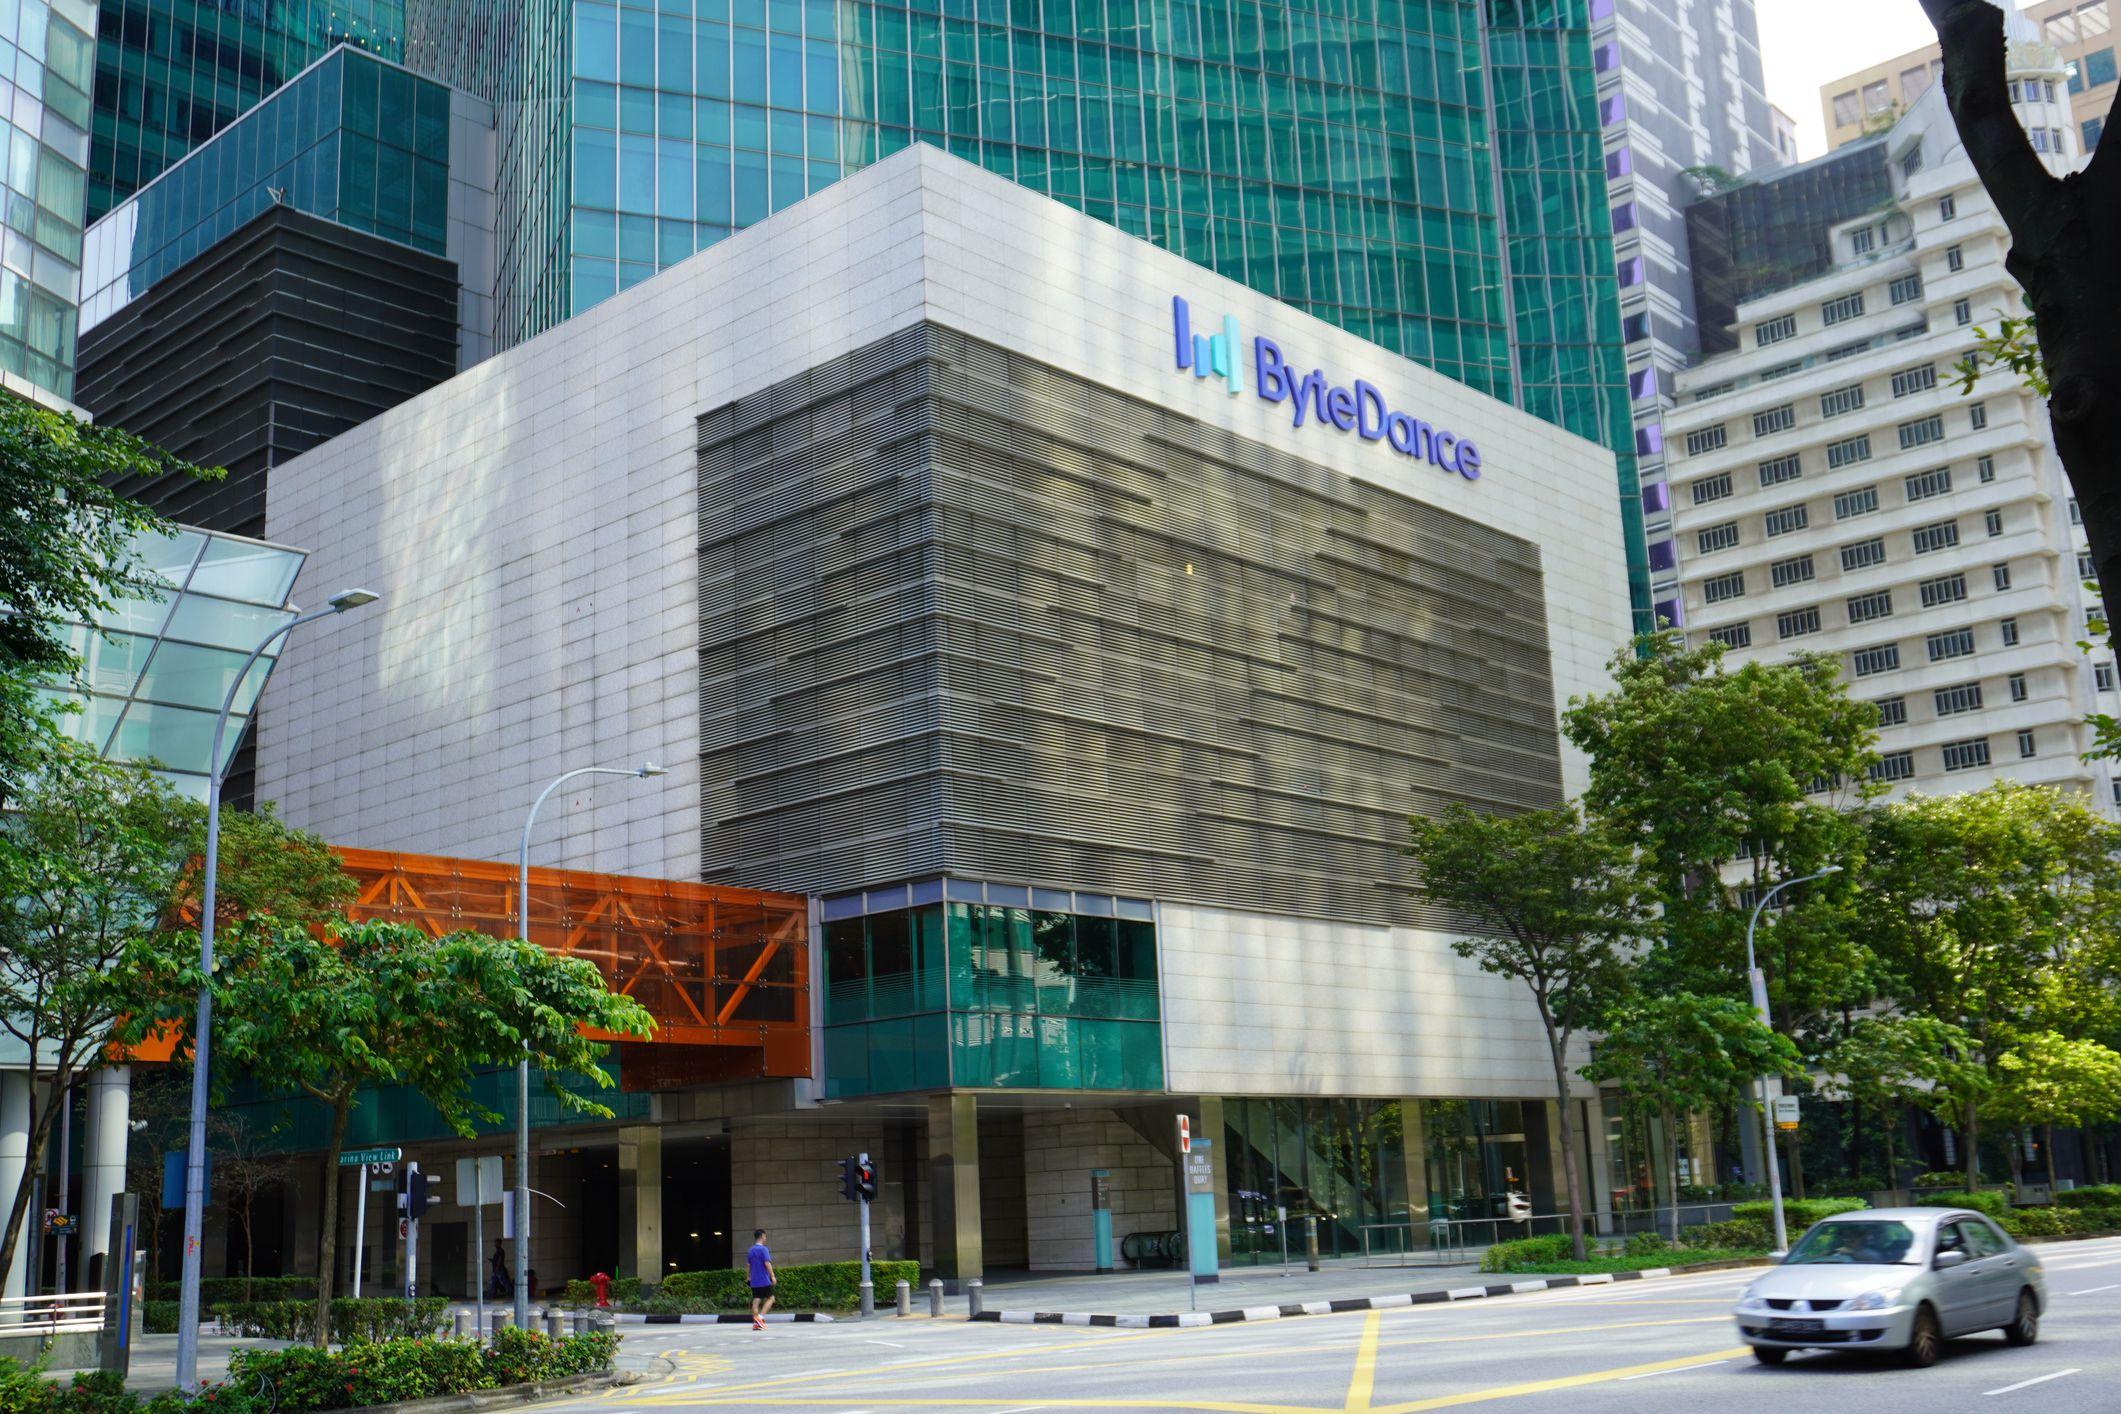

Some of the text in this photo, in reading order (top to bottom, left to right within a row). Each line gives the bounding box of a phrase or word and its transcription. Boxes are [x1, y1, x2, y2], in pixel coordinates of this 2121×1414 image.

[1255, 335, 1482, 480] ByteDance
[340, 1151, 396, 1163] arina View Link
[1194, 1155, 1205, 1164] ONE
[1189, 1165, 1211, 1174] RAFFLES
[1193, 1175, 1209, 1184] QUAY
